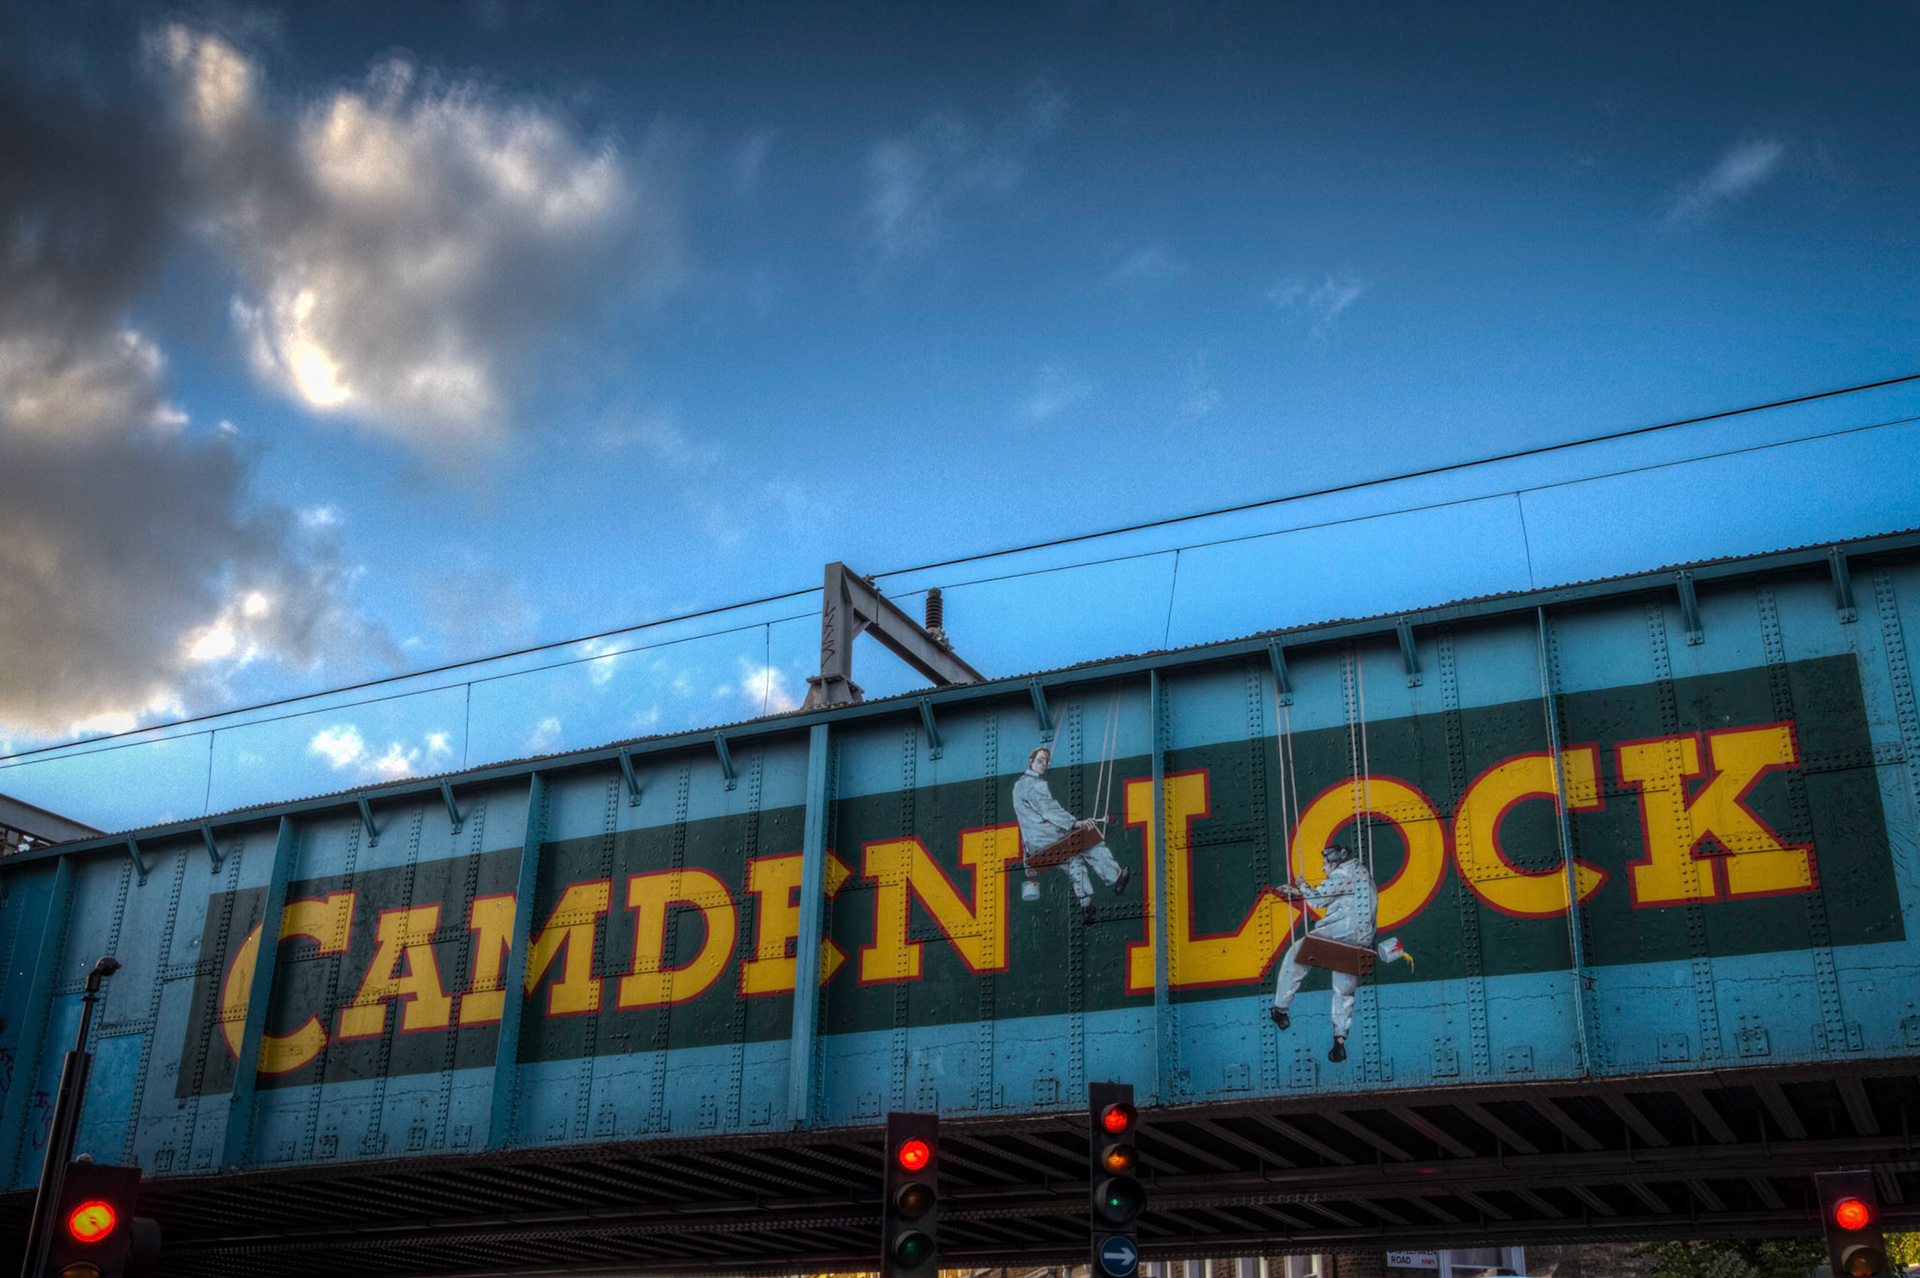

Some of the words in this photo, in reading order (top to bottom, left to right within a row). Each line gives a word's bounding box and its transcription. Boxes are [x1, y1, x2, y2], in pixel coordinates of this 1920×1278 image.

[221, 821, 1024, 1075] CAMDEN
[1123, 719, 1820, 996] LOCK
[1390, 1255, 1411, 1264] ROAD
